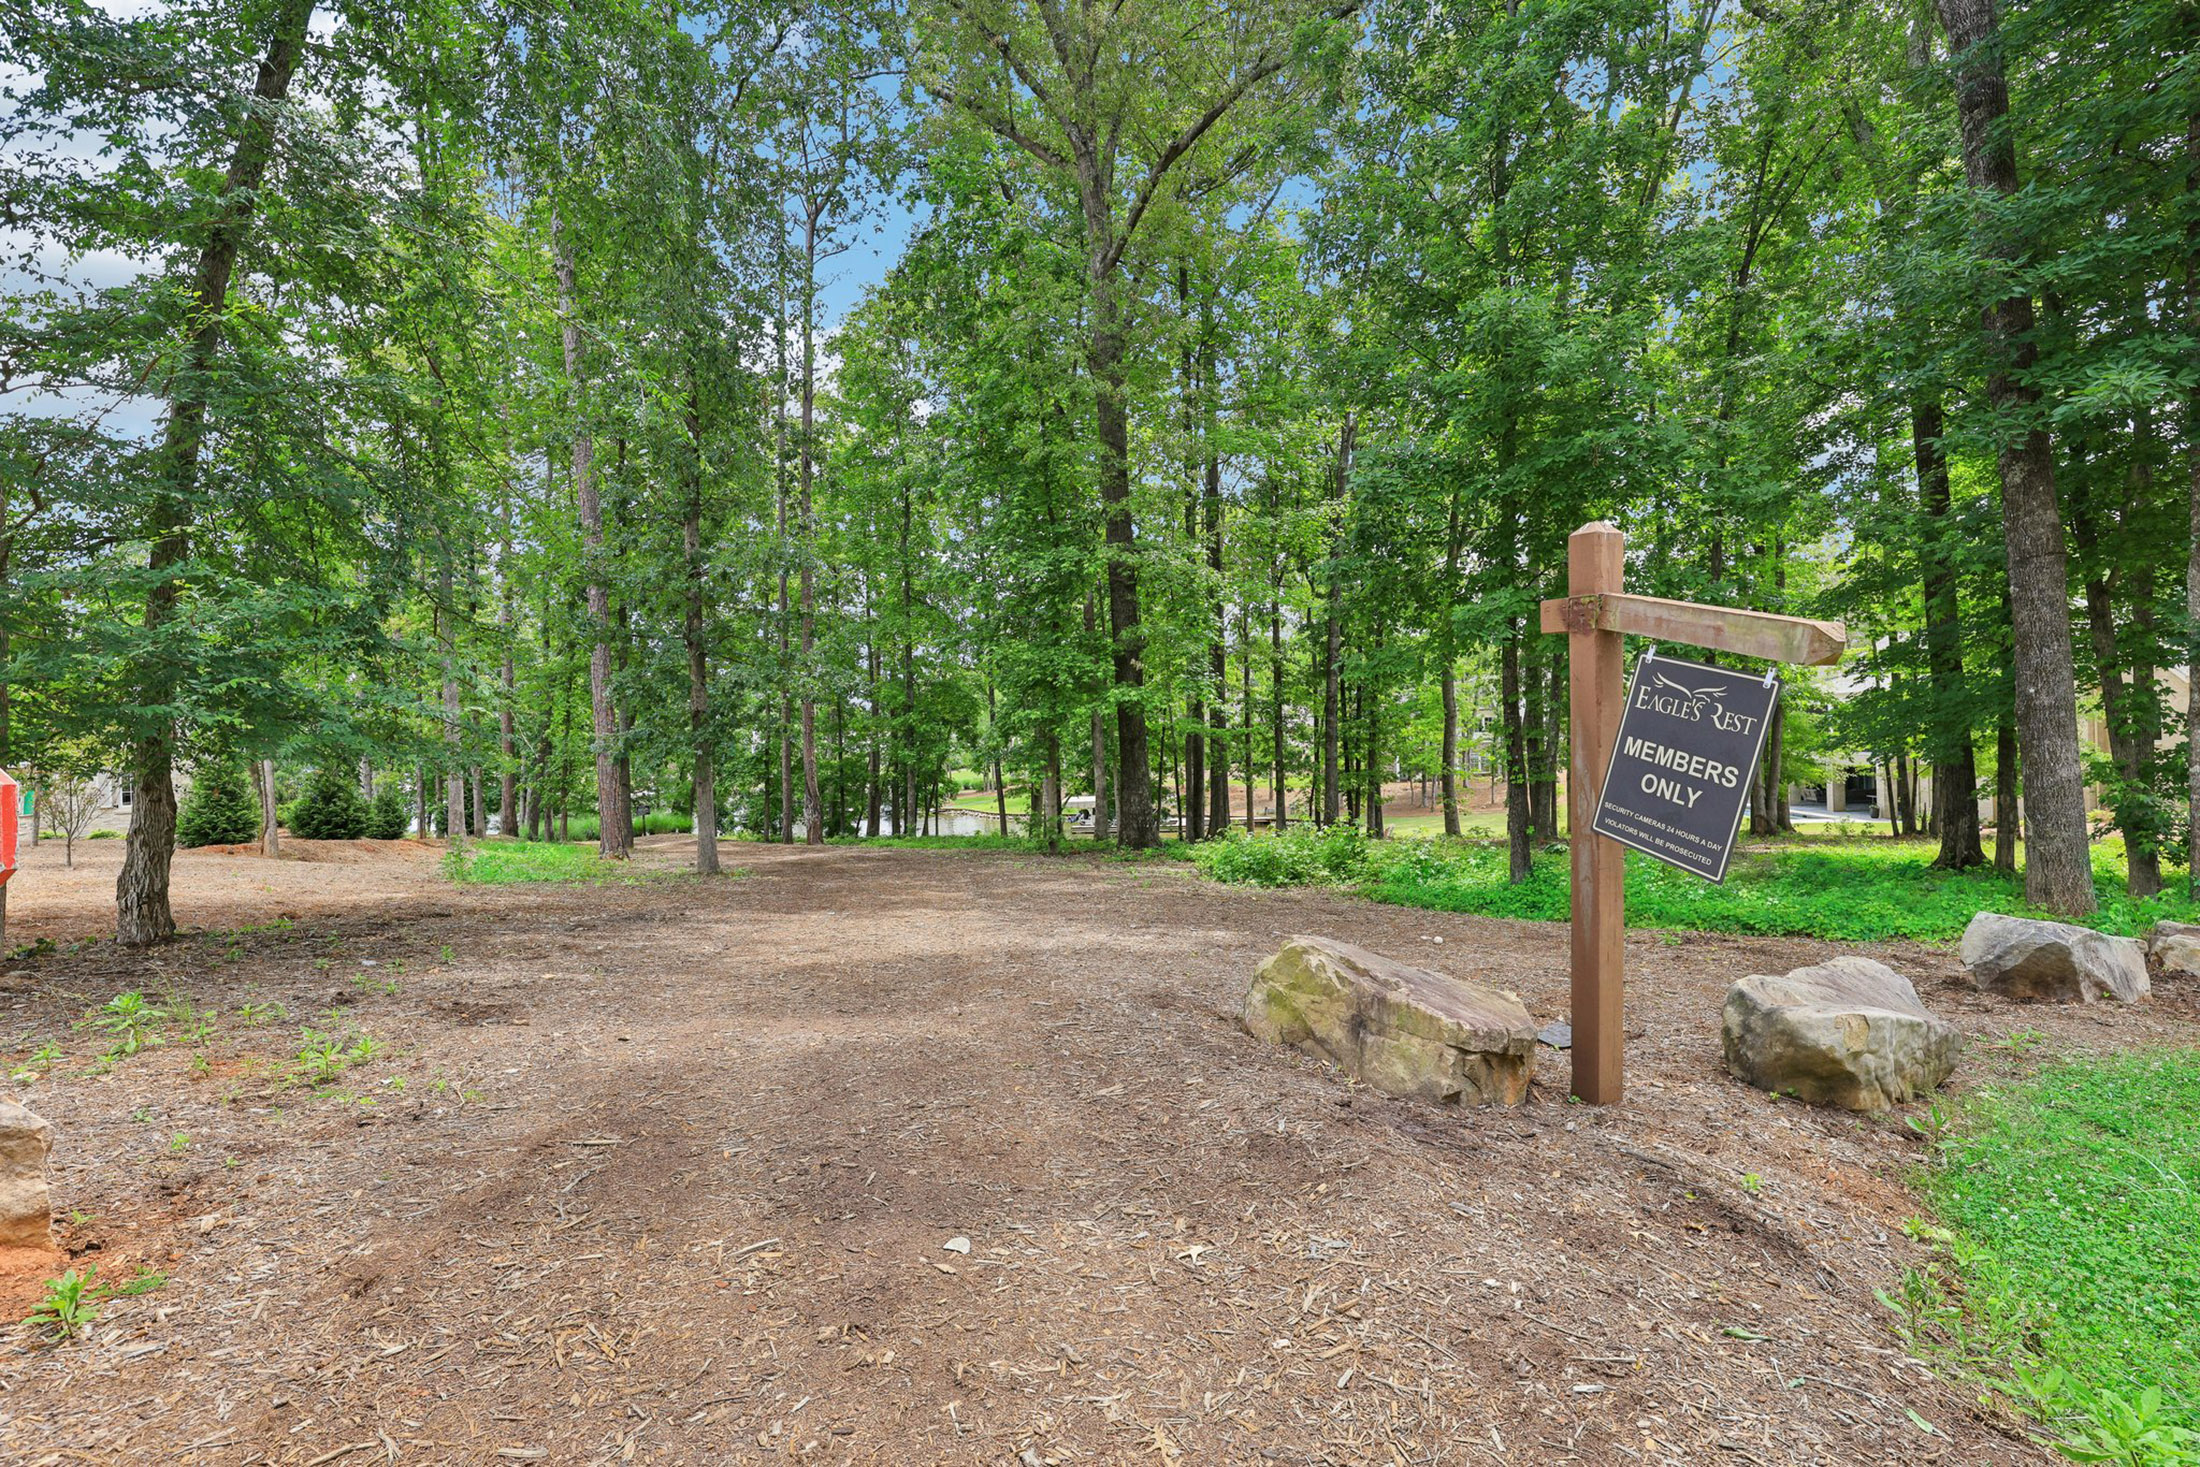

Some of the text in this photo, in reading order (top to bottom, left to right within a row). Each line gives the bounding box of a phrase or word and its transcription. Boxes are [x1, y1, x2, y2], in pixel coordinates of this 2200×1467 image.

[1635, 685, 1757, 735] EAGLE'S REST
[1624, 736, 1739, 787] MEMBERS
[1641, 774, 1703, 809] ONLY
[1604, 802, 1722, 852] SECURITY CAMERAS 24 HOURS A DAY
[1605, 817, 1712, 866] VIOLATORS WILL BE PROSECUTED
